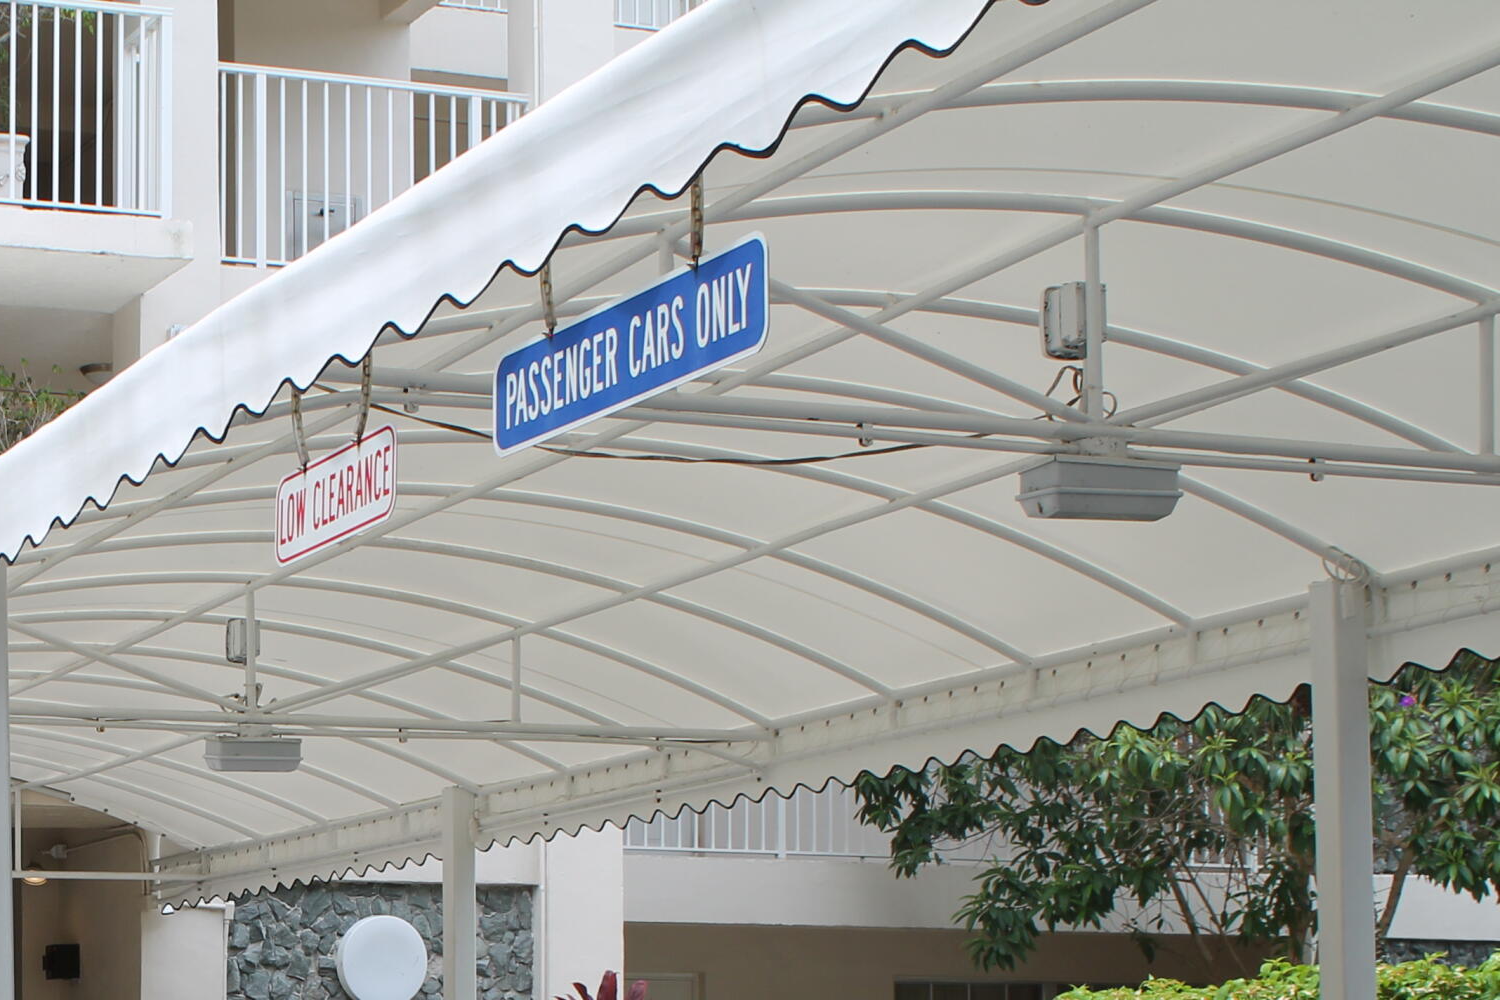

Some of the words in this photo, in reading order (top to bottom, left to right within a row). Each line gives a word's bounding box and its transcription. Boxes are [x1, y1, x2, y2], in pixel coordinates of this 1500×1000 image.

[506, 327, 618, 430] PASSENGER
[629, 295, 684, 378] CARS
[696, 263, 752, 348] ONLY
[280, 488, 306, 545] LOW
[313, 445, 391, 530] CLEARANCE
